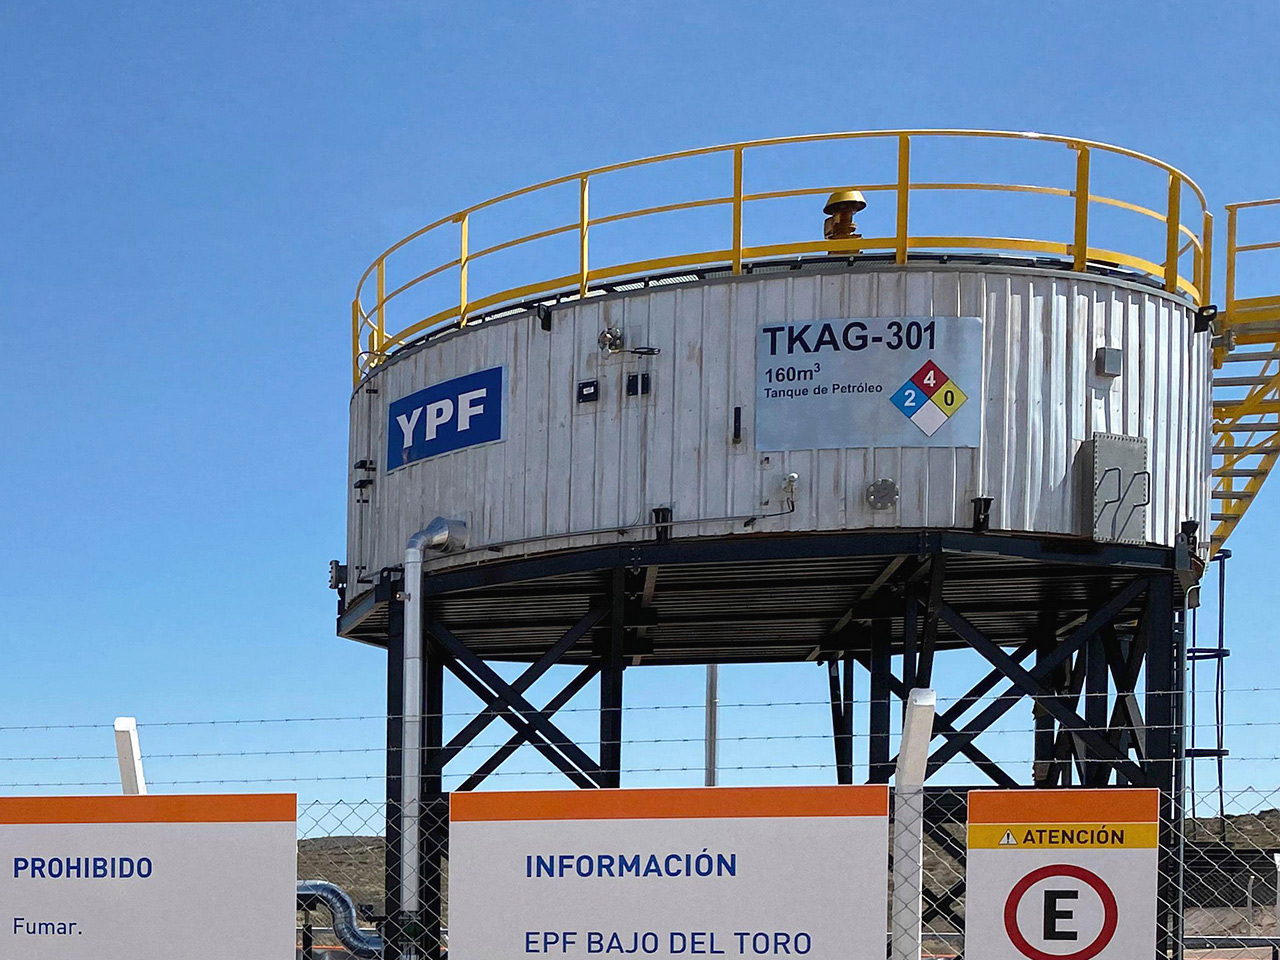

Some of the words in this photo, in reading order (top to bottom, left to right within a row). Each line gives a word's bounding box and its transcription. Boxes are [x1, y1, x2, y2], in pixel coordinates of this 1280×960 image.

[762, 320, 936, 356] TKAG-301
[923, 370, 936, 388] 4
[764, 387, 809, 399] Tanque
[813, 384, 828, 395] de
[832, 382, 883, 394] Petróleo
[904, 389, 916, 407] 2
[944, 389, 955, 407] 0
[396, 387, 487, 449] YPF
[1022, 824, 1125, 845] ATENCIÓN
[13, 857, 153, 879] PROHIBIDO
[526, 847, 736, 878] INFORMACIÓN
[13, 917, 82, 935] Fumar.
[1043, 889, 1079, 941] E
[525, 931, 578, 953] EPF
[587, 931, 659, 954] BAJO
[669, 932, 725, 954] DEL
[733, 932, 811, 955] TORO
